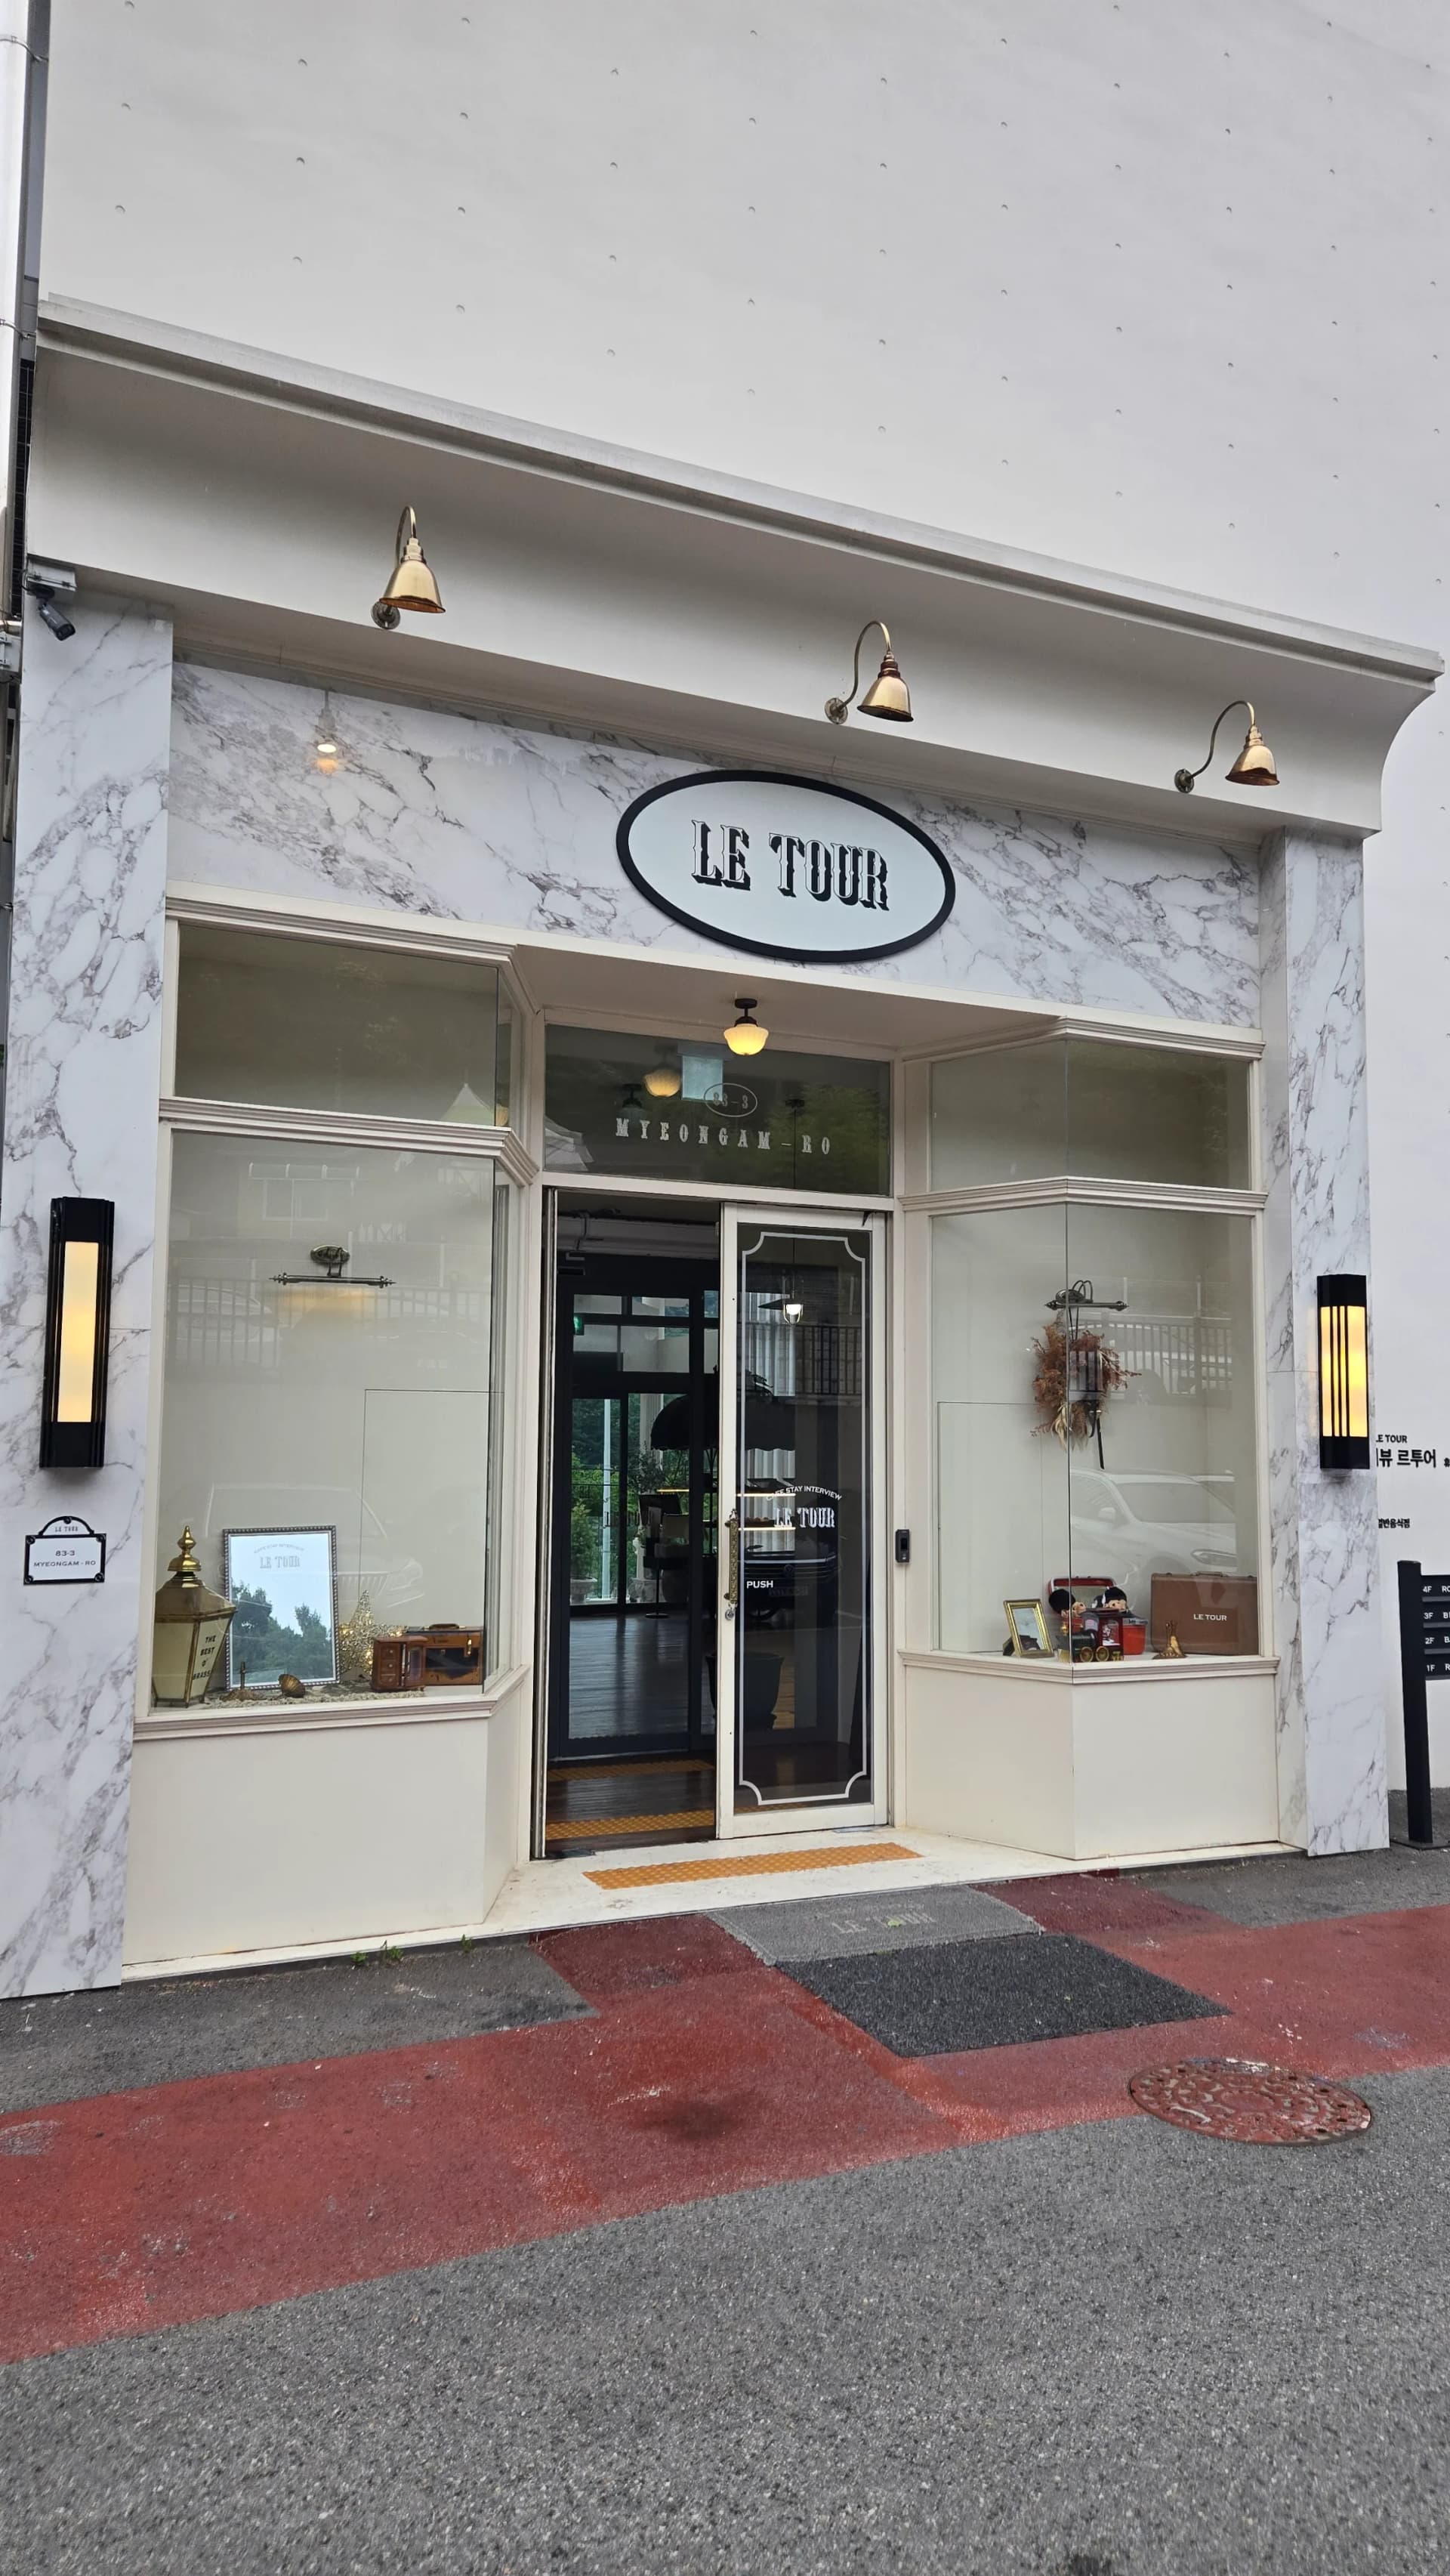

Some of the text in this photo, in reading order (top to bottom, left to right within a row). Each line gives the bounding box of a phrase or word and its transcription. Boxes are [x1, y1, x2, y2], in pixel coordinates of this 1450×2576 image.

[690, 819, 890, 911] LE TOUR
[1385, 1435, 1407, 1443] TOUR
[1397, 1449, 1436, 1468] 르투어
[785, 1485, 804, 1493] STAY
[804, 1485, 843, 1501] INTERVIEW
[773, 1506, 836, 1528] LE TOUR
[746, 1580, 773, 1589] PUSH
[1422, 1585, 1433, 1593] 4F
[1206, 1614, 1227, 1622] TOUR
[205, 1635, 217, 1644] THE
[200, 1646, 215, 1657] BEST
[1427, 1663, 1436, 1673] 1F
